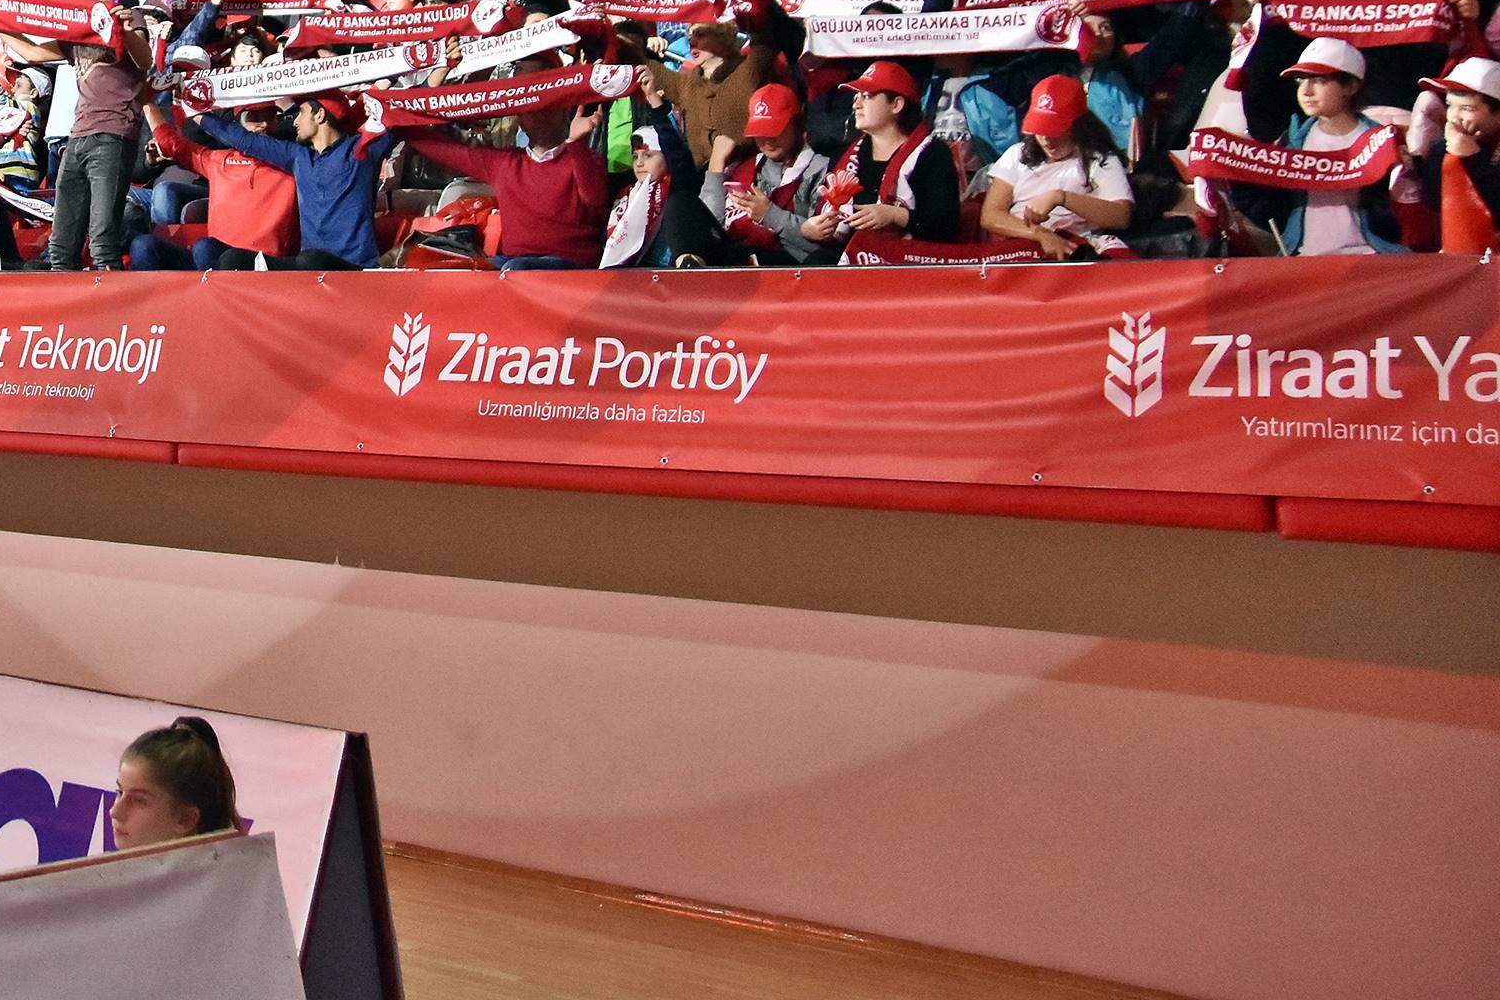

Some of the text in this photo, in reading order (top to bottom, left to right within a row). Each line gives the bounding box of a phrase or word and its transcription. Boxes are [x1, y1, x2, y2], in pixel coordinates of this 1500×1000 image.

[1301, 2, 1436, 20] BANKASI SPOR
[429, 72, 584, 110] BANKASI SPOR KULÜBÜ
[1202, 134, 1288, 166] BANKASI
[1291, 153, 1345, 173] SPOR
[18, 324, 166, 385] Teknoloji
[437, 332, 769, 406] Ziraat Portföy
[1188, 333, 1403, 400] Ziraat
[22, 381, 42, 397] için
[44, 382, 95, 401] teknoloji
[477, 399, 705, 423] Uzmanlığımızla daha fazlası
[1240, 416, 1403, 442] Yatırımlarınız
[1412, 420, 1457, 446] için
